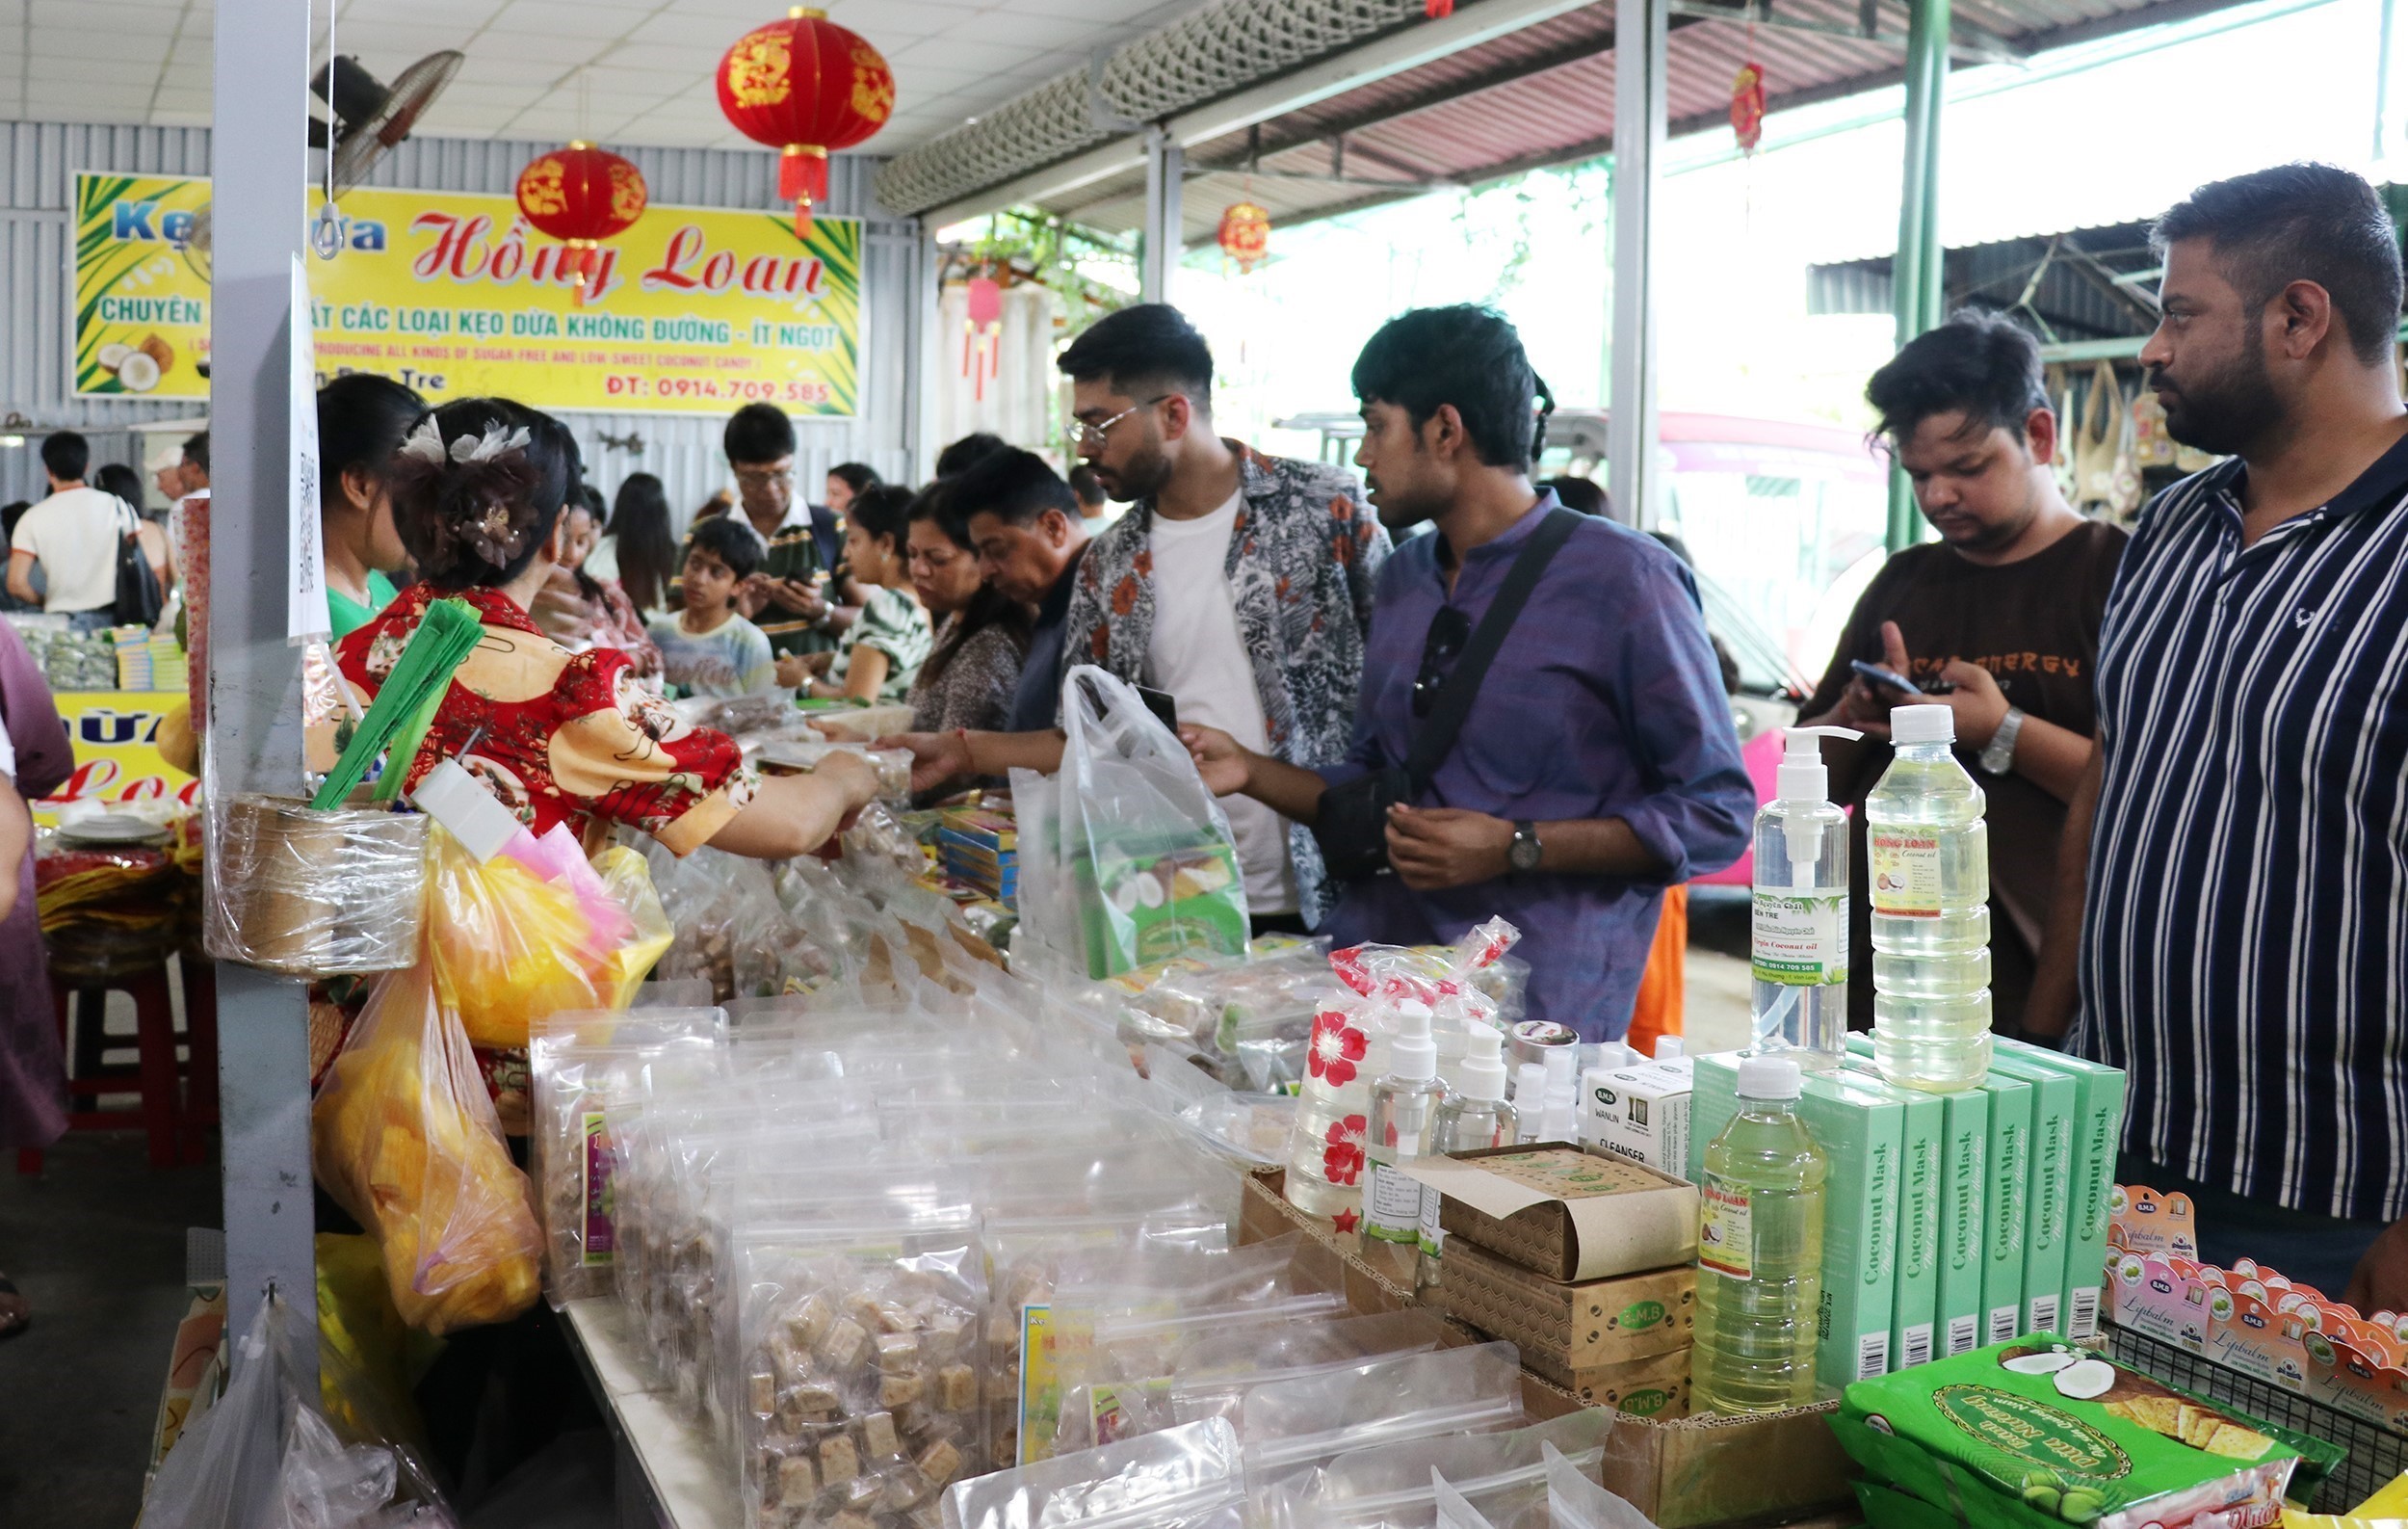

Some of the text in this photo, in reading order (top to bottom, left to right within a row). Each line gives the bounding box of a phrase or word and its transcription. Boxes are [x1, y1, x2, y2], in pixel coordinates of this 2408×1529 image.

[116, 201, 196, 250] Kẹ
[642, 225, 831, 296] Loan
[101, 294, 200, 324] CHUYÊN
[342, 302, 389, 330] CÁC
[399, 308, 450, 338] LOẠI
[459, 311, 504, 341] KẸO
[512, 306, 559, 336] DỪA
[568, 312, 644, 339] KHÔNG
[653, 314, 730, 343] ĐƯỜNG
[752, 318, 772, 345] ÍT
[780, 326, 837, 353] NGỌT
[387, 345, 406, 356] ALL
[412, 346, 450, 358] KINDS
[552, 350, 576, 363] AND
[401, 369, 445, 388] Tre
[607, 376, 648, 396] ĐT:
[658, 378, 829, 402] 0914.709.585
[1771, 941, 1803, 950] Coconut
[1952, 1130, 1971, 1270] Coconut Mask
[1995, 1123, 2015, 1261] Coconut Mask
[2037, 1115, 2058, 1250] Coconut Mask
[2080, 1107, 2107, 1242] Coconut Mask
[1865, 1143, 1886, 1284] Coconut Mask
[1907, 1138, 1925, 1279] Coconut Mask
[1623, 1305, 1661, 1325] B.M.B
[2152, 1280, 2170, 1292] B.M.B
[2243, 1314, 2263, 1328] B.M.B
[1993, 1397, 2028, 1411] Nam
